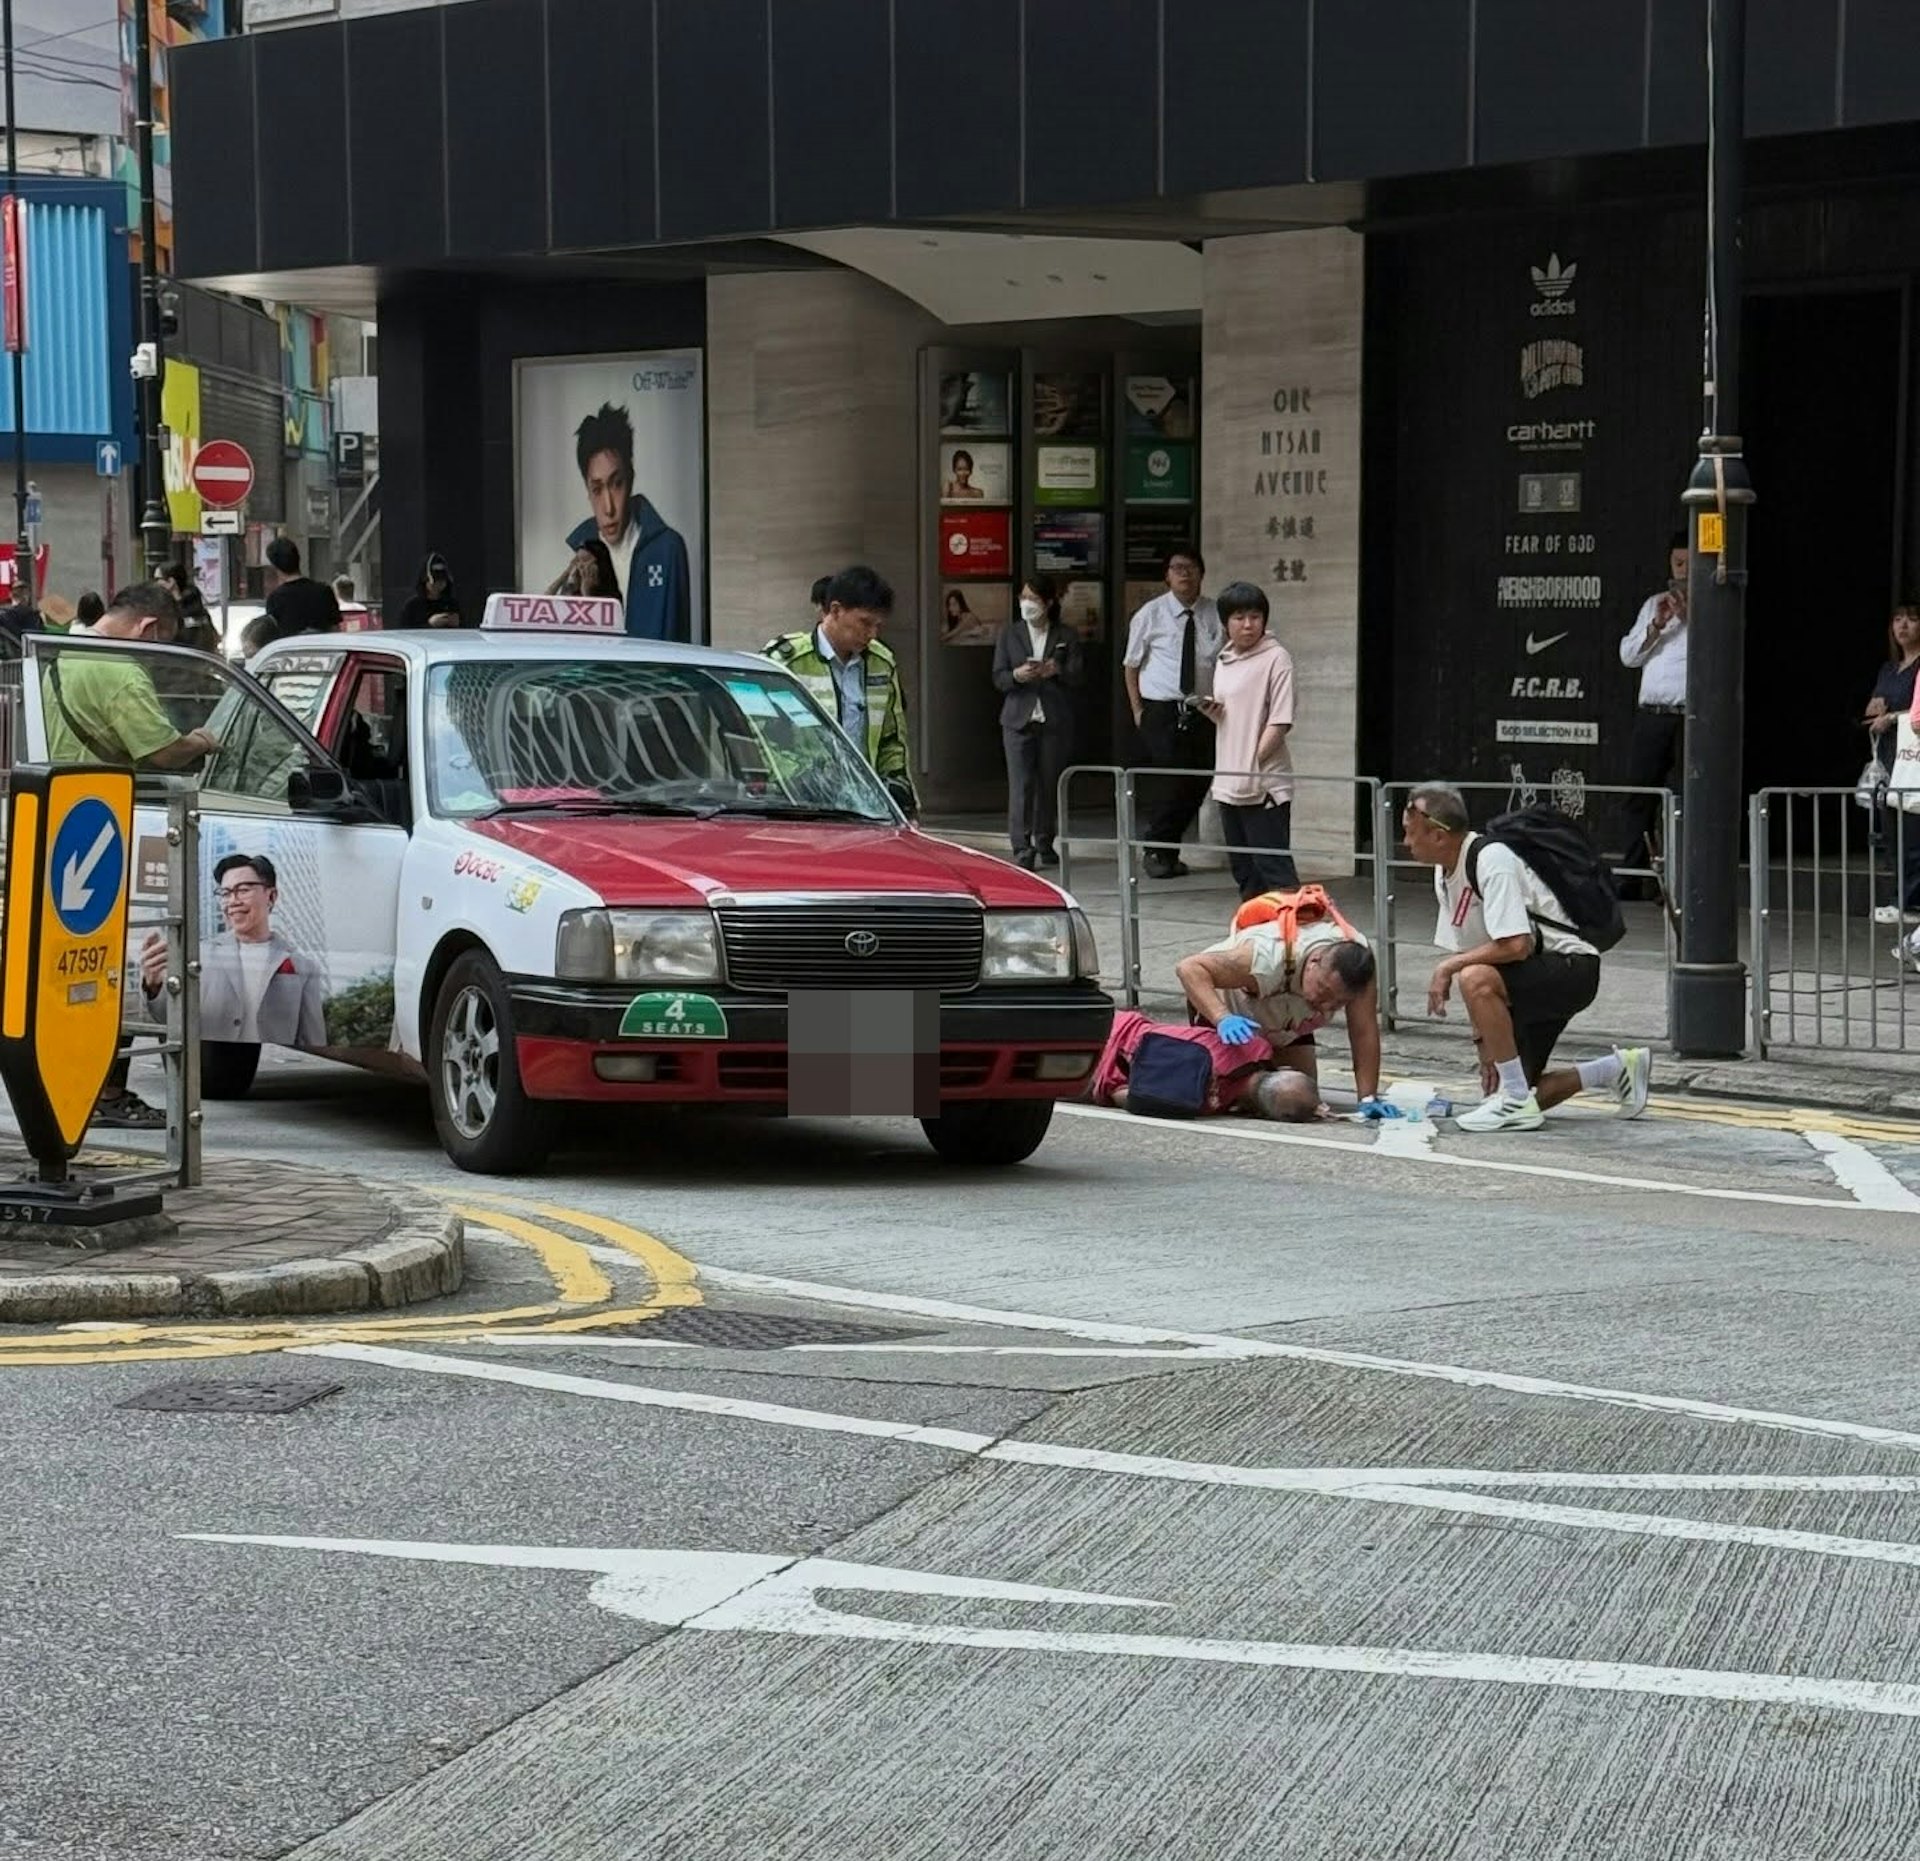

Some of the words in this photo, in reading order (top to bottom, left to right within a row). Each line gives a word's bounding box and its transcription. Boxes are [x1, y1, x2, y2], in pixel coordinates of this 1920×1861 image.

[1507, 420, 1596, 442] carhartt
[338, 434, 359, 463] P
[1255, 470, 1327, 496] AVENUE
[1505, 535, 1540, 554] FEAR
[1546, 535, 1561, 553] OF
[1568, 534, 1596, 553] GOD
[1497, 576, 1601, 600] NEIGHBORHOOD
[503, 598, 615, 627] TAXI
[1511, 677, 1584, 699] F.C.R.B.
[58, 946, 108, 976] 47597
[664, 998, 687, 1021] 4
[641, 1021, 706, 1034] SEATS
